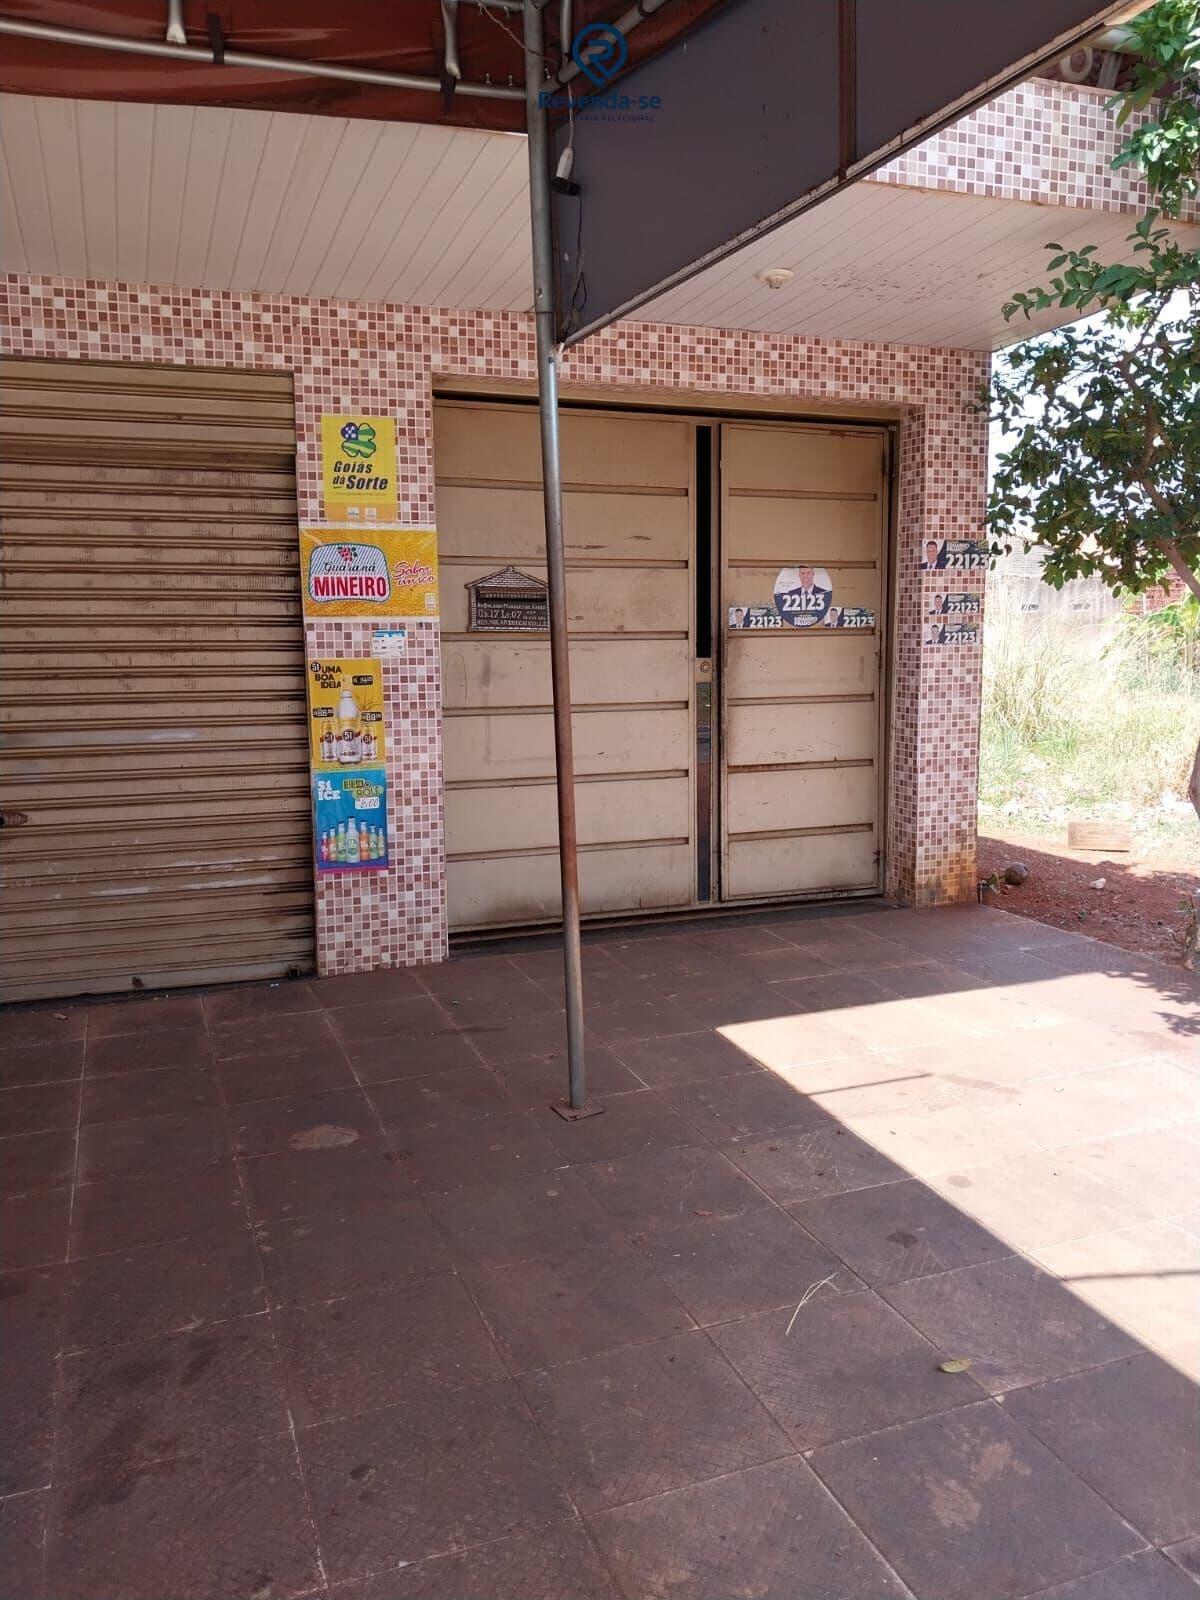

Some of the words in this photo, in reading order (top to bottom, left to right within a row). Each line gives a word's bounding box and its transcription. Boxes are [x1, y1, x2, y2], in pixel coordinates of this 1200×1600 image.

[334, 461, 373, 473] Goiás
[346, 475, 388, 490] Sorte
[945, 554, 989, 569] 22123
[324, 562, 376, 574] Guaraná
[392, 560, 432, 578] Sabor
[313, 576, 387, 597] MINEIRO
[782, 594, 825, 611] 22123
[947, 602, 979, 614] 22123
[749, 616, 782, 627] 22123
[843, 616, 875, 627] 22123
[945, 631, 976, 643] 22123
[321, 665, 342, 673] UMA
[315, 673, 334, 681] BOA
[318, 790, 341, 800] ICE
